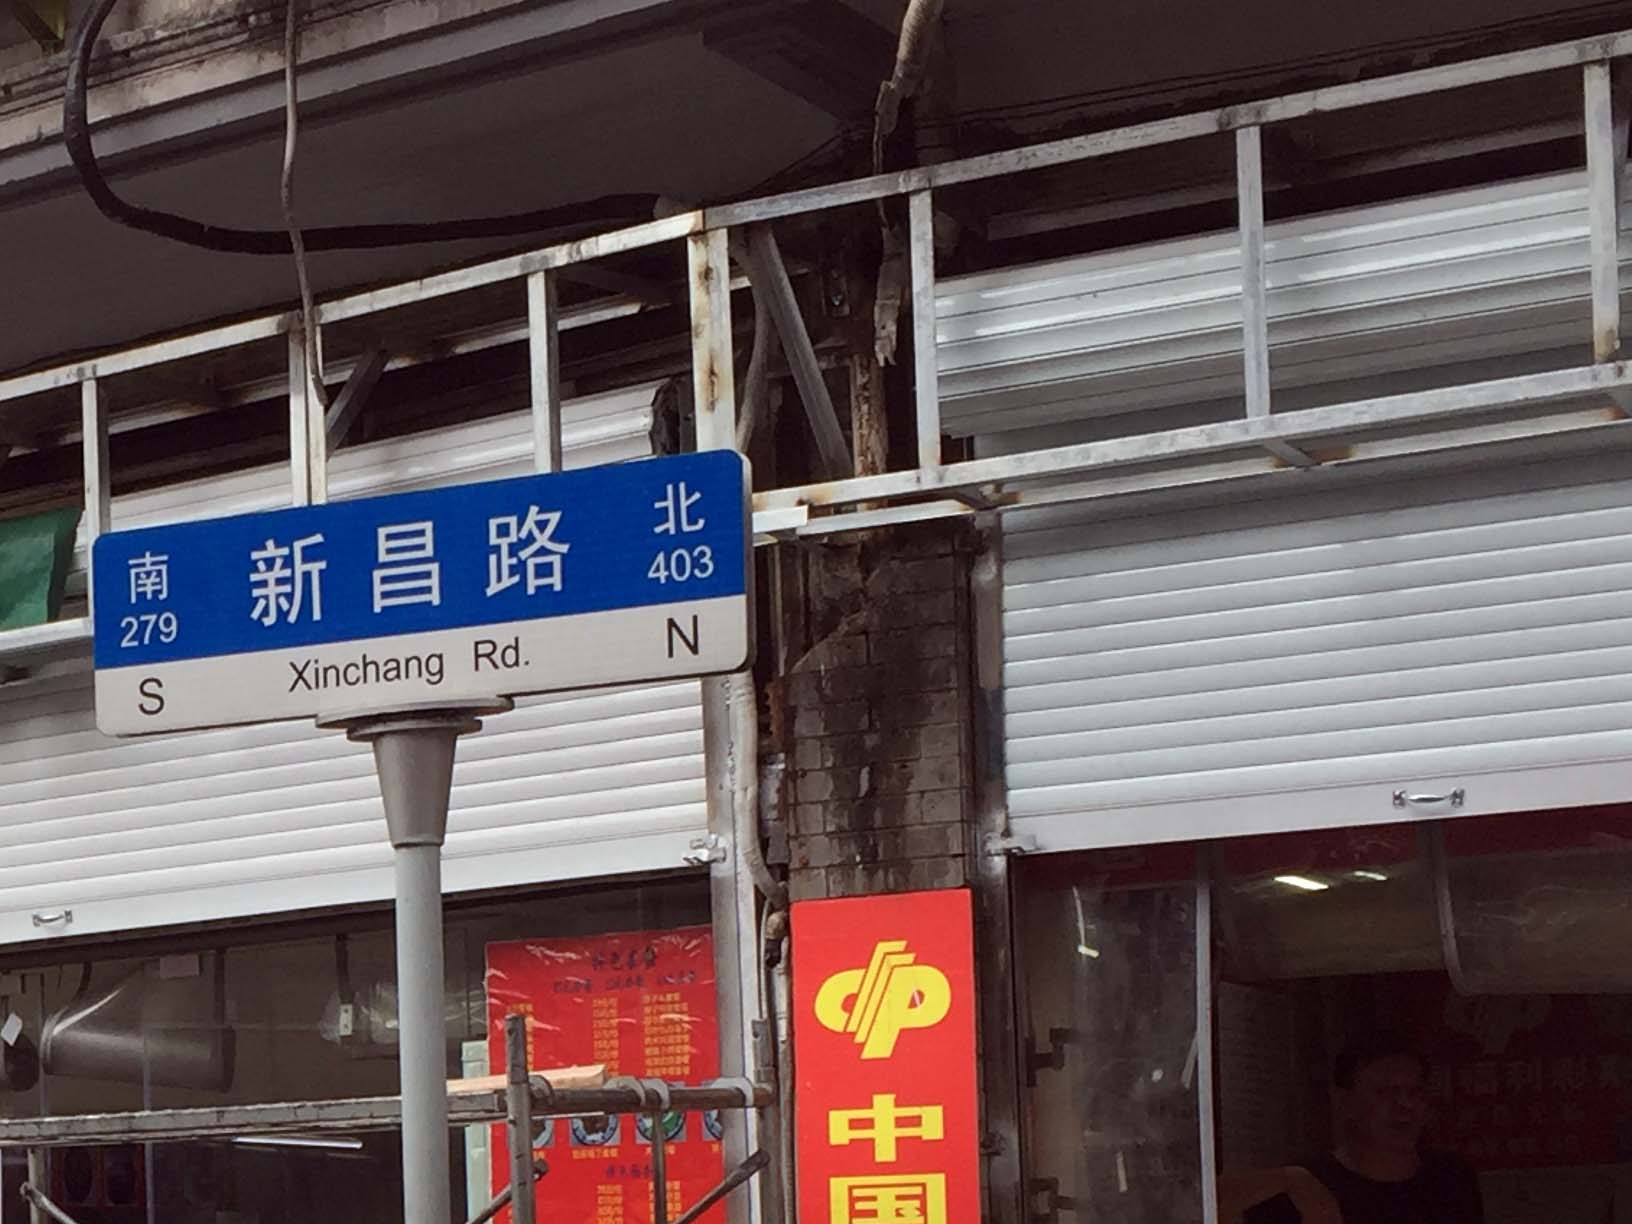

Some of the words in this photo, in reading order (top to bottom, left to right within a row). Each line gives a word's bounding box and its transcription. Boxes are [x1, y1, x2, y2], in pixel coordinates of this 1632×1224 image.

[653, 480, 706, 537] 北
[128, 551, 169, 603] 南
[248, 505, 571, 626] 新昌路
[647, 545, 714, 586] 403
[119, 610, 178, 649] 279
[666, 614, 700, 659] N
[288, 646, 445, 693] Xinchang
[472, 638, 530, 672] Rd.
[137, 678, 166, 716] S
